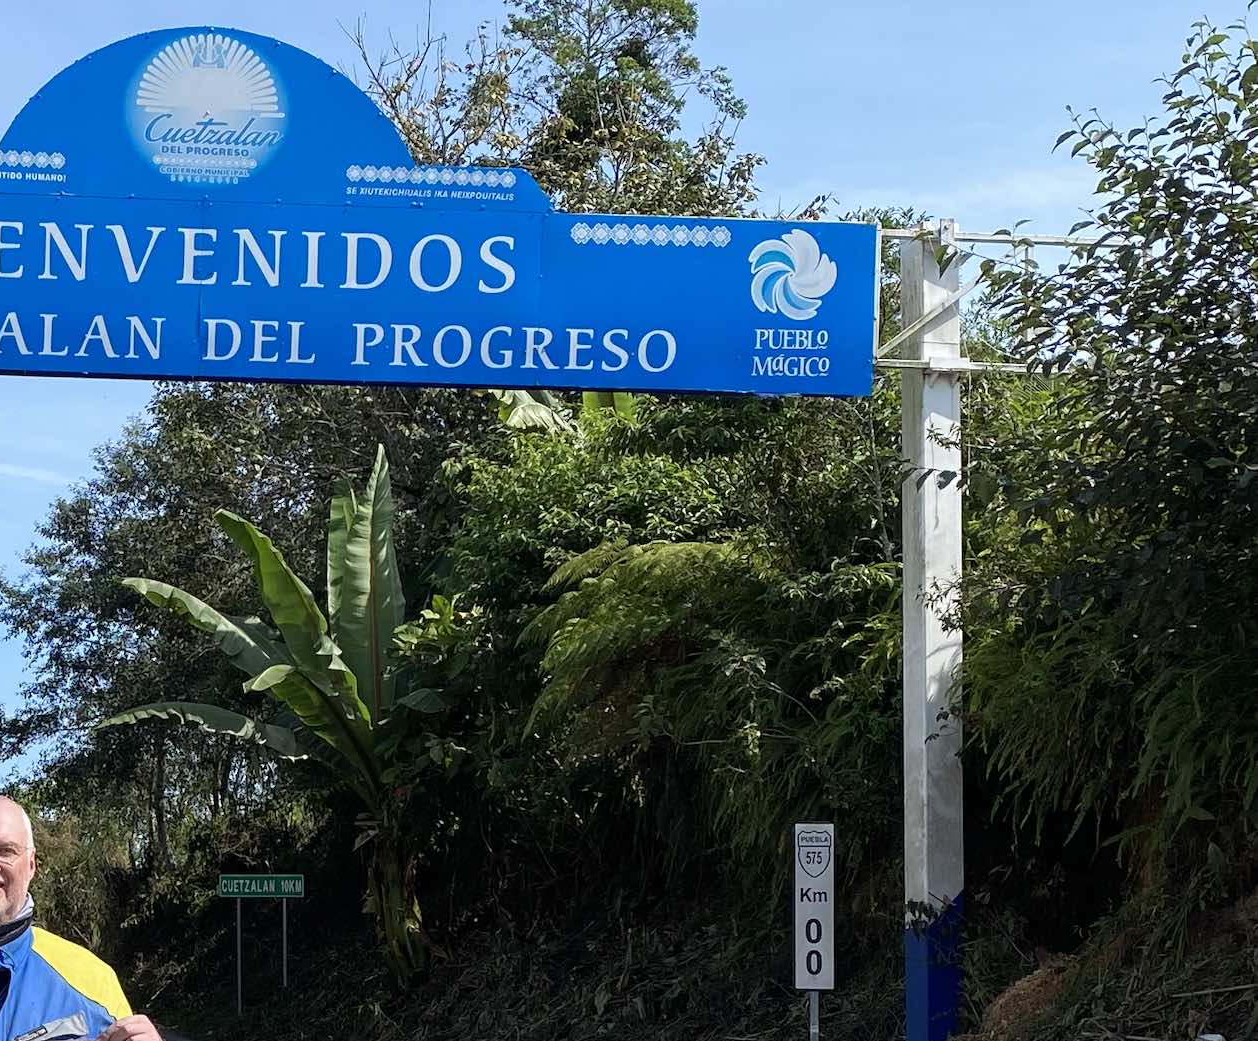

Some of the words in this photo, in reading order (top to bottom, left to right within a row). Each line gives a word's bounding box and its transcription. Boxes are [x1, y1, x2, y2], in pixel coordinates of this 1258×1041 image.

[145, 113, 283, 147] Cuetzalan
[161, 145, 183, 154] DEL
[186, 147, 250, 157] PROGRESO
[160, 166, 203, 176] GOBIERNO
[204, 168, 250, 177] MUNICIPAL
[345, 187, 358, 195] SE
[202, 319, 316, 364] DEL
[351, 323, 677, 373] PROGRESO
[806, 851, 823, 865] 575
[222, 879, 275, 893] CUETZALAN
[281, 879, 302, 893] 10KM
[800, 887, 828, 902] Km
[805, 918, 822, 944] 0
[806, 950, 822, 975] 0
